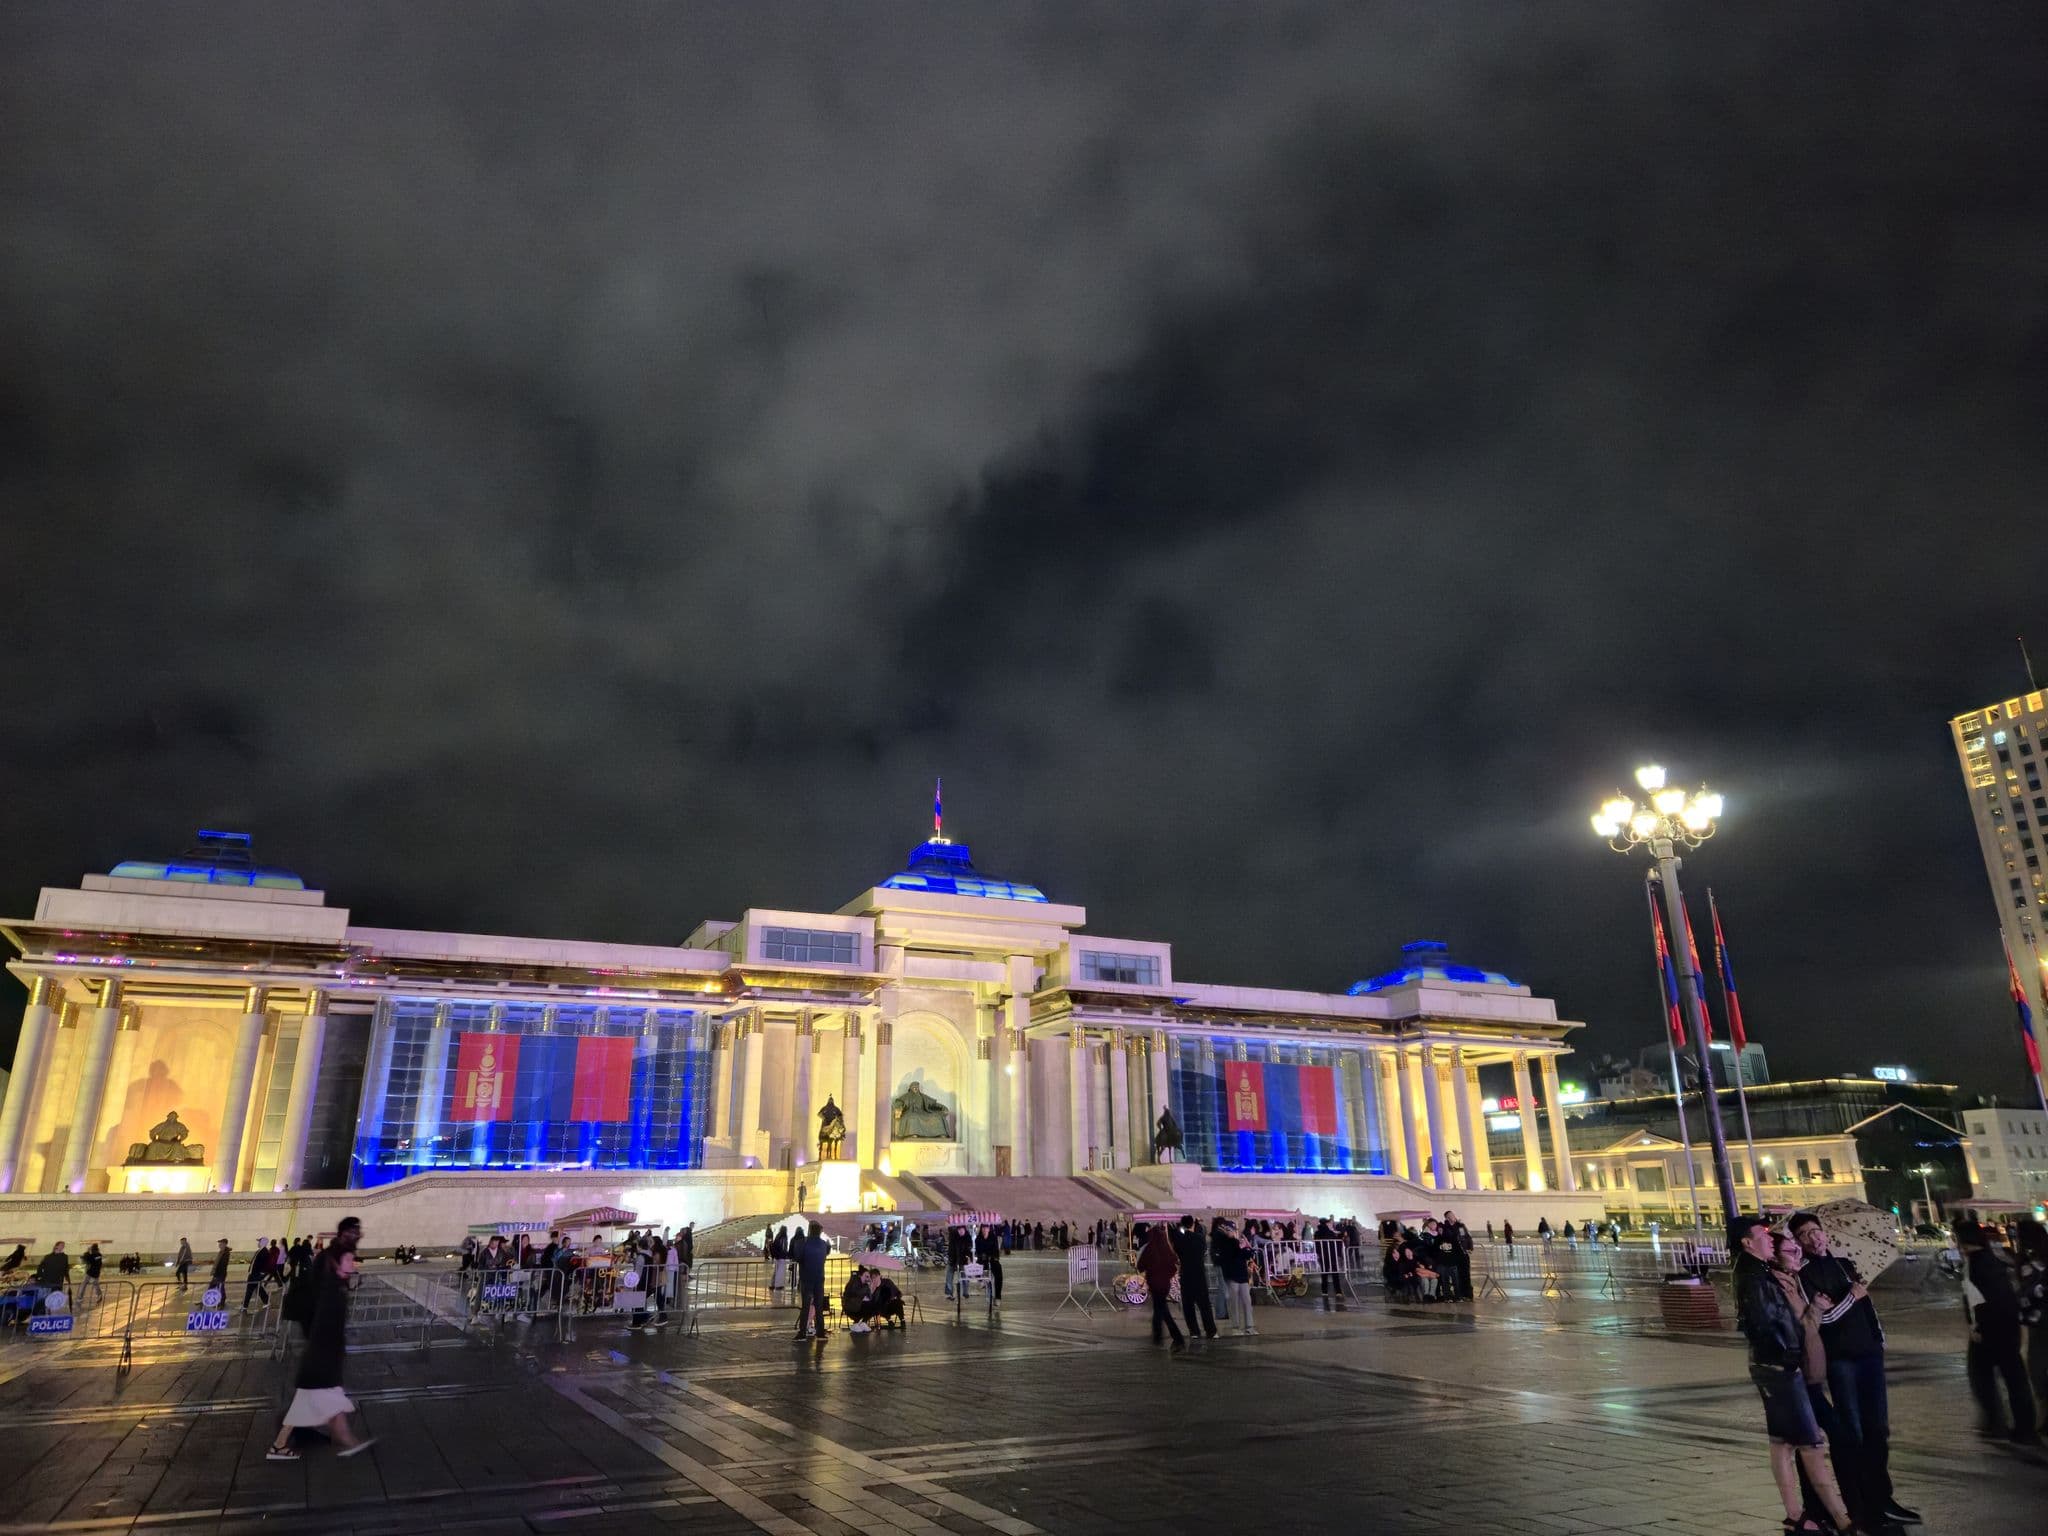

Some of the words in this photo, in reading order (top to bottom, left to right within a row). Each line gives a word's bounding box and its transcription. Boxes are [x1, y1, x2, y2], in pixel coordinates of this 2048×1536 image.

[484, 1285, 517, 1298] POLICE
[31, 1319, 71, 1331] POLICE
[186, 1311, 228, 1330] POLICE
